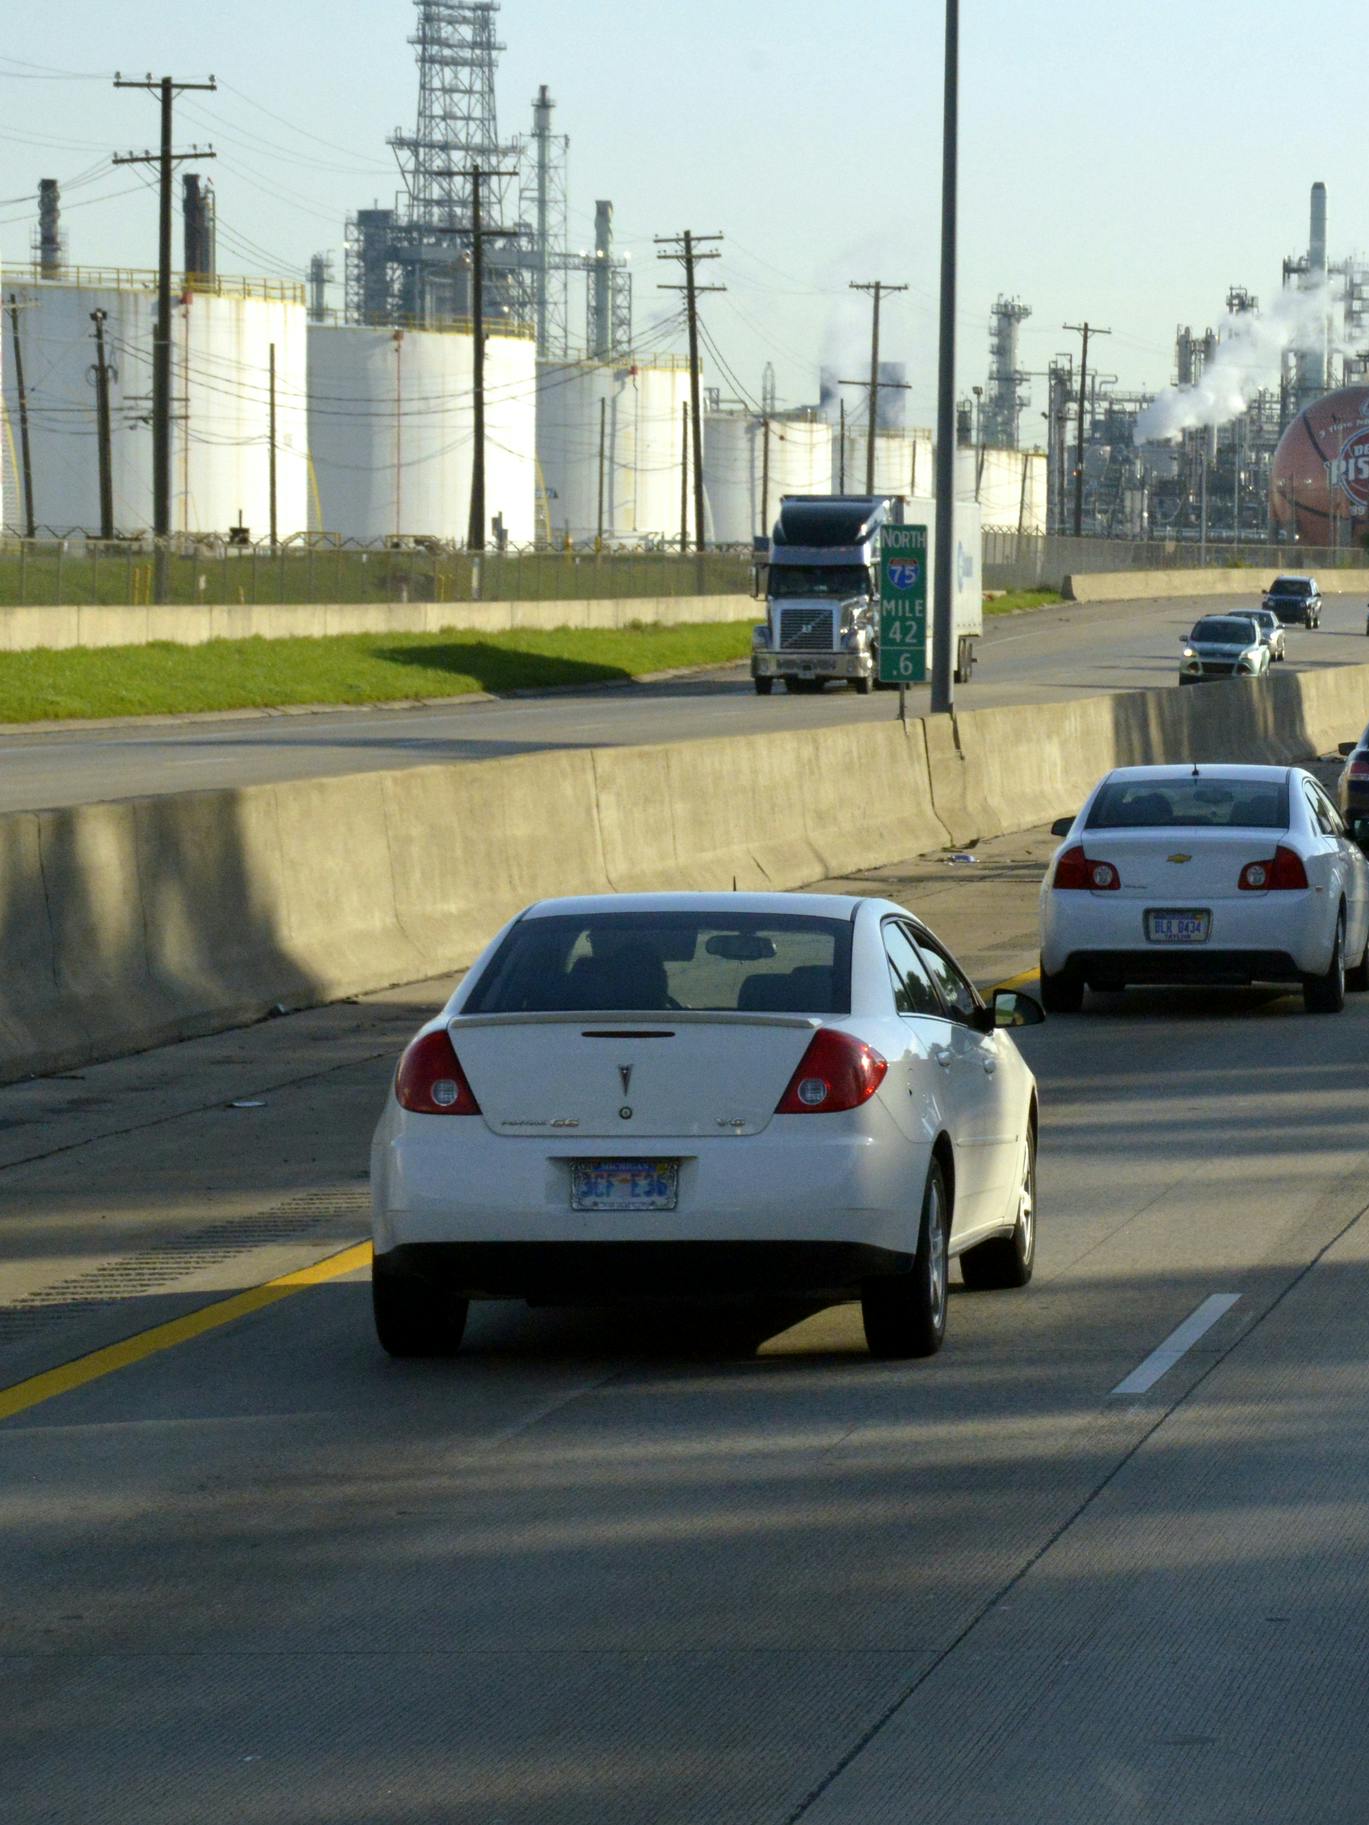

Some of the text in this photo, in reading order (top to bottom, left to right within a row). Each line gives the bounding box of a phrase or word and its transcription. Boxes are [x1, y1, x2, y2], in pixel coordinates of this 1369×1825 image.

[881, 530, 927, 549] NORTH
[893, 566, 917, 584] 75
[882, 600, 924, 617] MILE
[889, 620, 918, 643] 42
